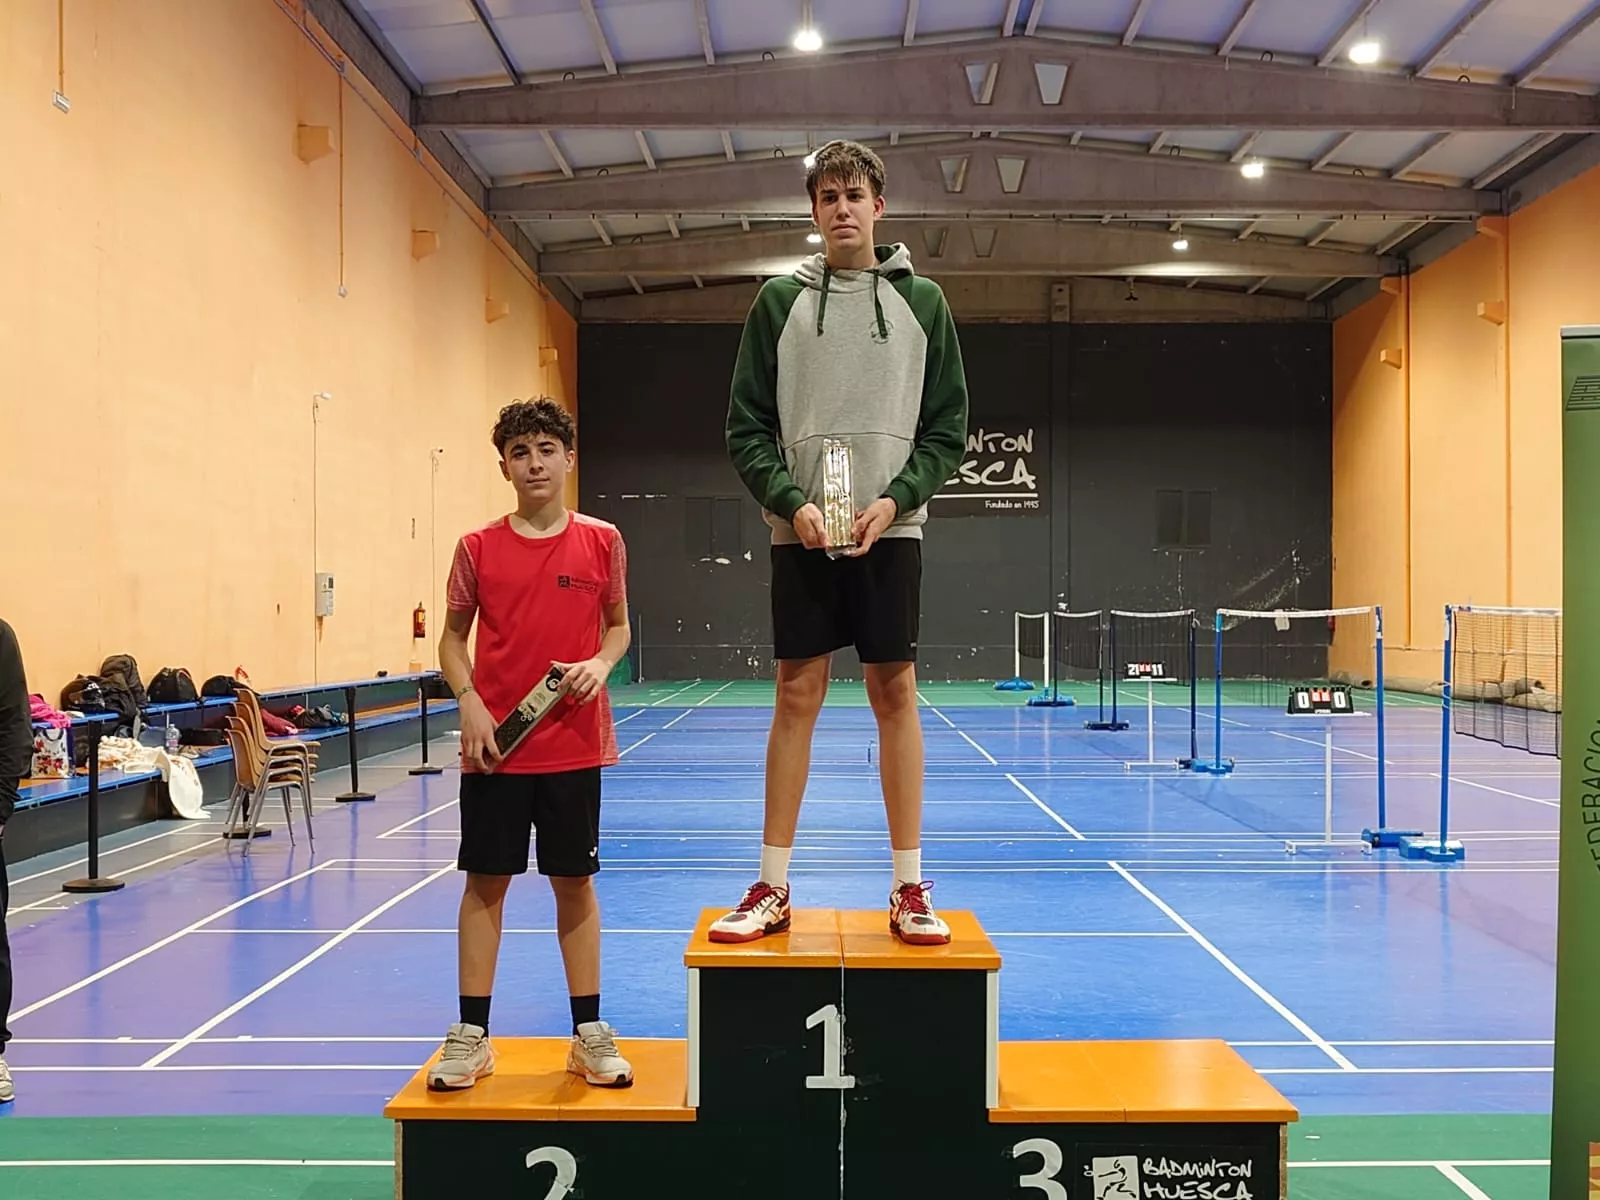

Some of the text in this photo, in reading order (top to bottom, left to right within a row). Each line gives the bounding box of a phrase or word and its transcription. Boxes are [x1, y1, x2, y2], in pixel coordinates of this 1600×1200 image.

[967, 428, 1033, 453] NTON
[944, 457, 1037, 490] SCA
[1127, 663, 1140, 676] 21
[1151, 663, 1164, 676] 11
[1297, 691, 1310, 709] 0
[1333, 691, 1346, 709] 0
[805, 1004, 856, 1089] 1
[525, 1146, 577, 1200] 2
[1012, 1138, 1067, 1200] 3
[1143, 1180, 1253, 1200] HUESCA
